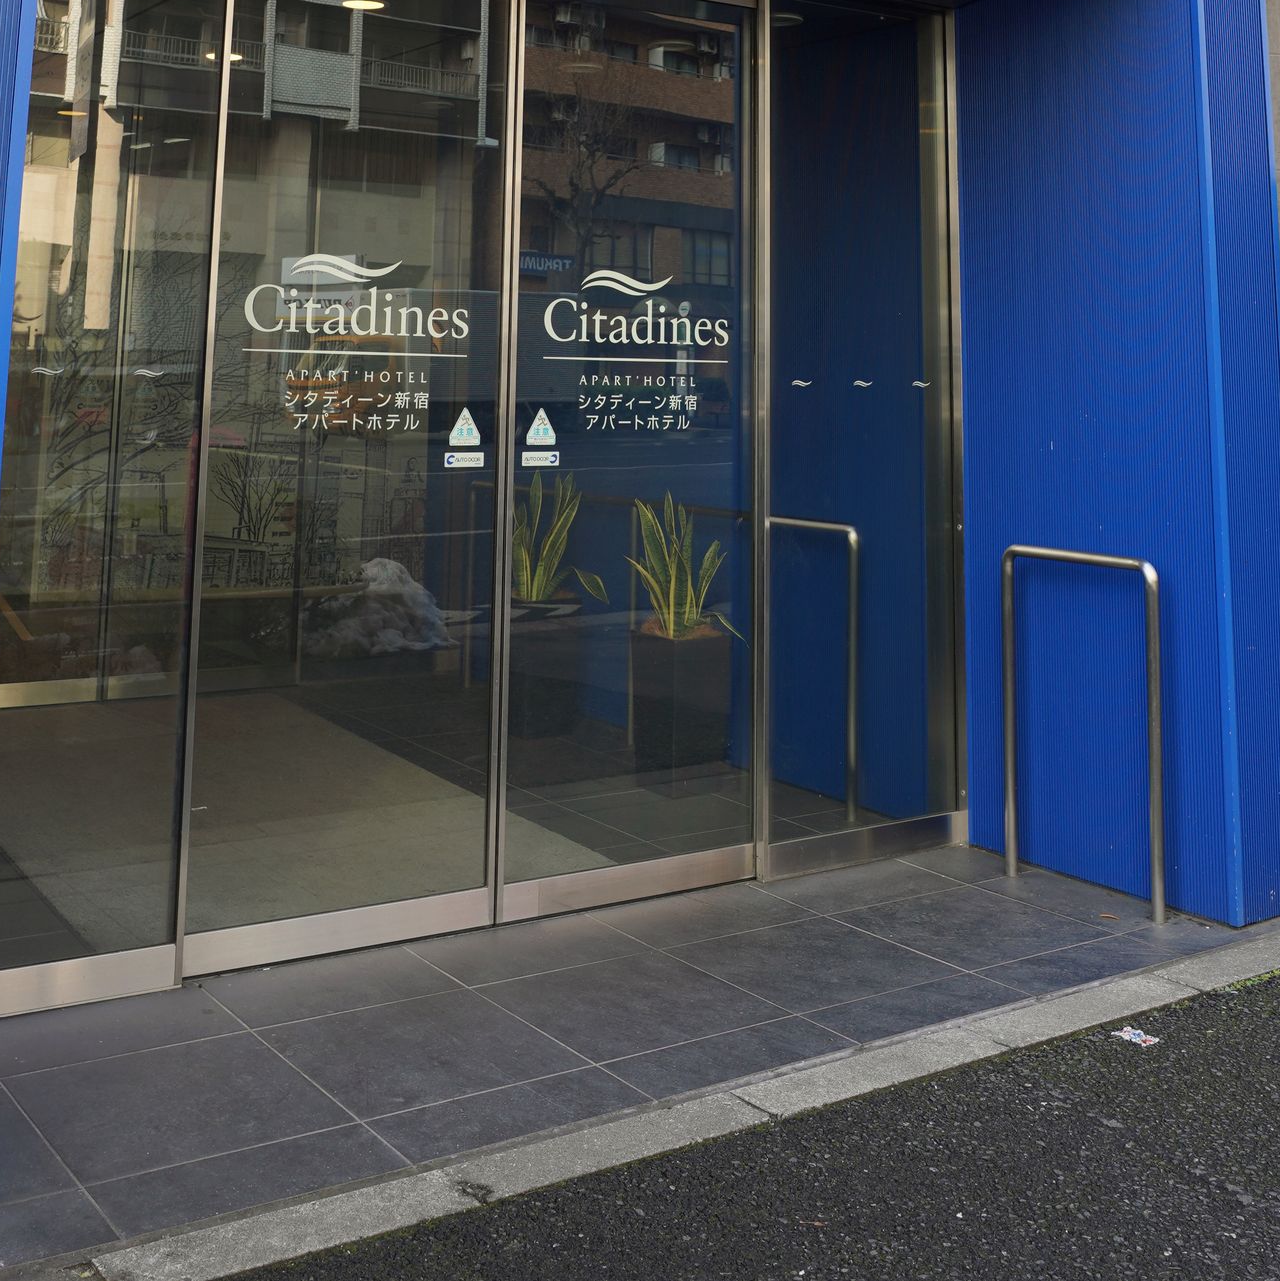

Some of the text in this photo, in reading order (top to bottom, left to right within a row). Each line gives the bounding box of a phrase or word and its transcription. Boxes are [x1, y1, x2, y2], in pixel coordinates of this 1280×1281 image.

[244, 284, 469, 339] Citadines
[544, 298, 730, 347] Citadines
[286, 370, 428, 384] APART'HOTEL
[579, 375, 697, 387] APART'HOTEL
[285, 390, 430, 410] シタディーン新宿
[578, 394, 698, 411] シタディーン新宿
[293, 413, 420, 431] アパートホテル
[586, 414, 690, 431] アパートホテル
